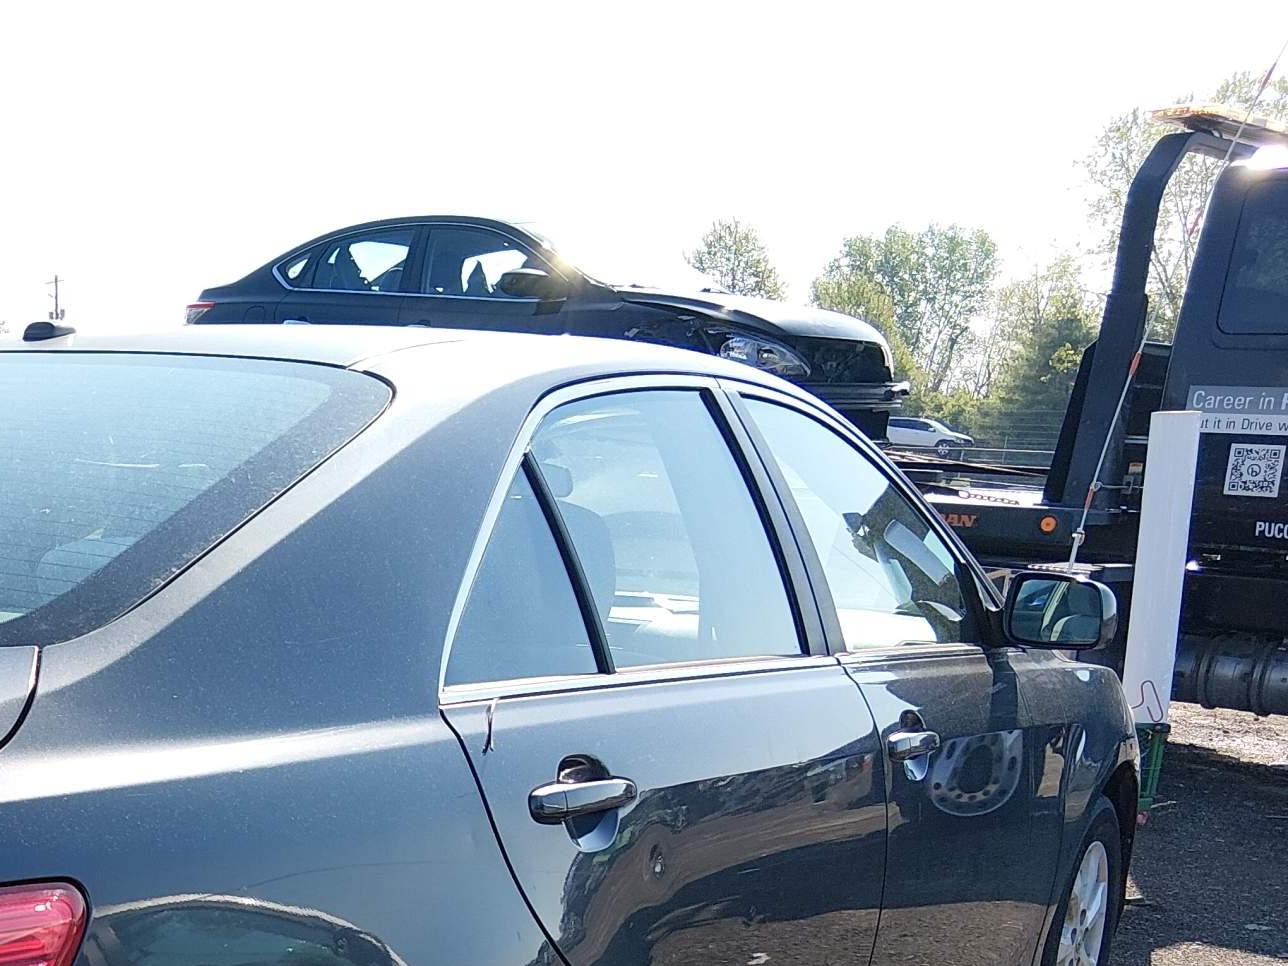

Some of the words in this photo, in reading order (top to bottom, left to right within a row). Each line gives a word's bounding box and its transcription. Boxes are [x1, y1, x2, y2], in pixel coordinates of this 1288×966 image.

[1192, 390, 1255, 410] Career
[1258, 392, 1275, 411] in
[1213, 416, 1221, 429] it
[1226, 417, 1236, 429] in
[1241, 418, 1273, 431] Drive
